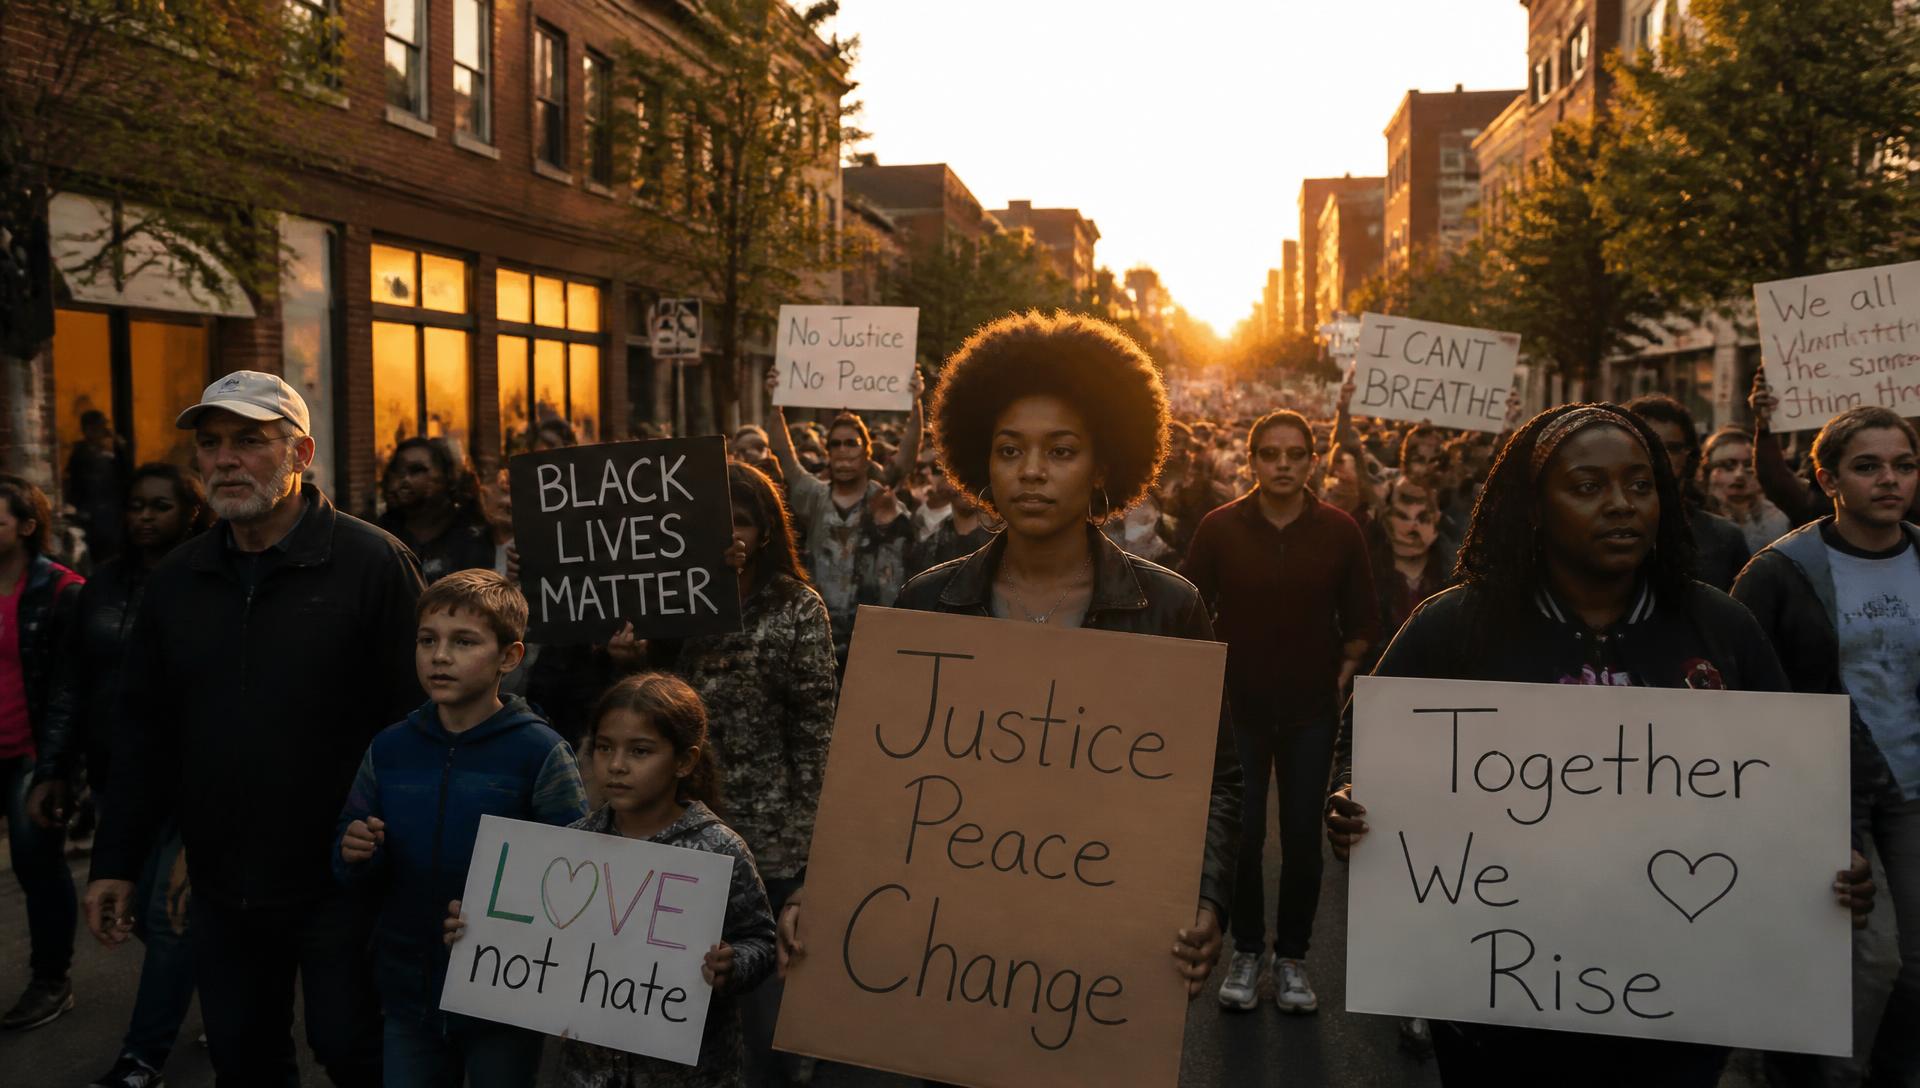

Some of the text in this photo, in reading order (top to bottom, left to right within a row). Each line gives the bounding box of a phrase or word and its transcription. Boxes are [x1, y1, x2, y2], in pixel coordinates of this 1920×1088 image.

[1769, 274, 1896, 322] We all
[789, 316, 904, 348] No Justice
[1369, 325, 1496, 372] I CANT
[789, 360, 900, 393] No Peace
[1360, 367, 1507, 421] BREATHE
[537, 455, 695, 513] BLACK
[556, 513, 687, 564] LIVES
[540, 566, 719, 623] MATTER
[876, 649, 1173, 780] Justice
[1413, 708, 1771, 826] Together
[904, 774, 1116, 887] Peace
[1399, 831, 1520, 908] We
[469, 937, 688, 1023] not hate
[843, 882, 1129, 1051] Change
[1470, 928, 1675, 1020] Rise
